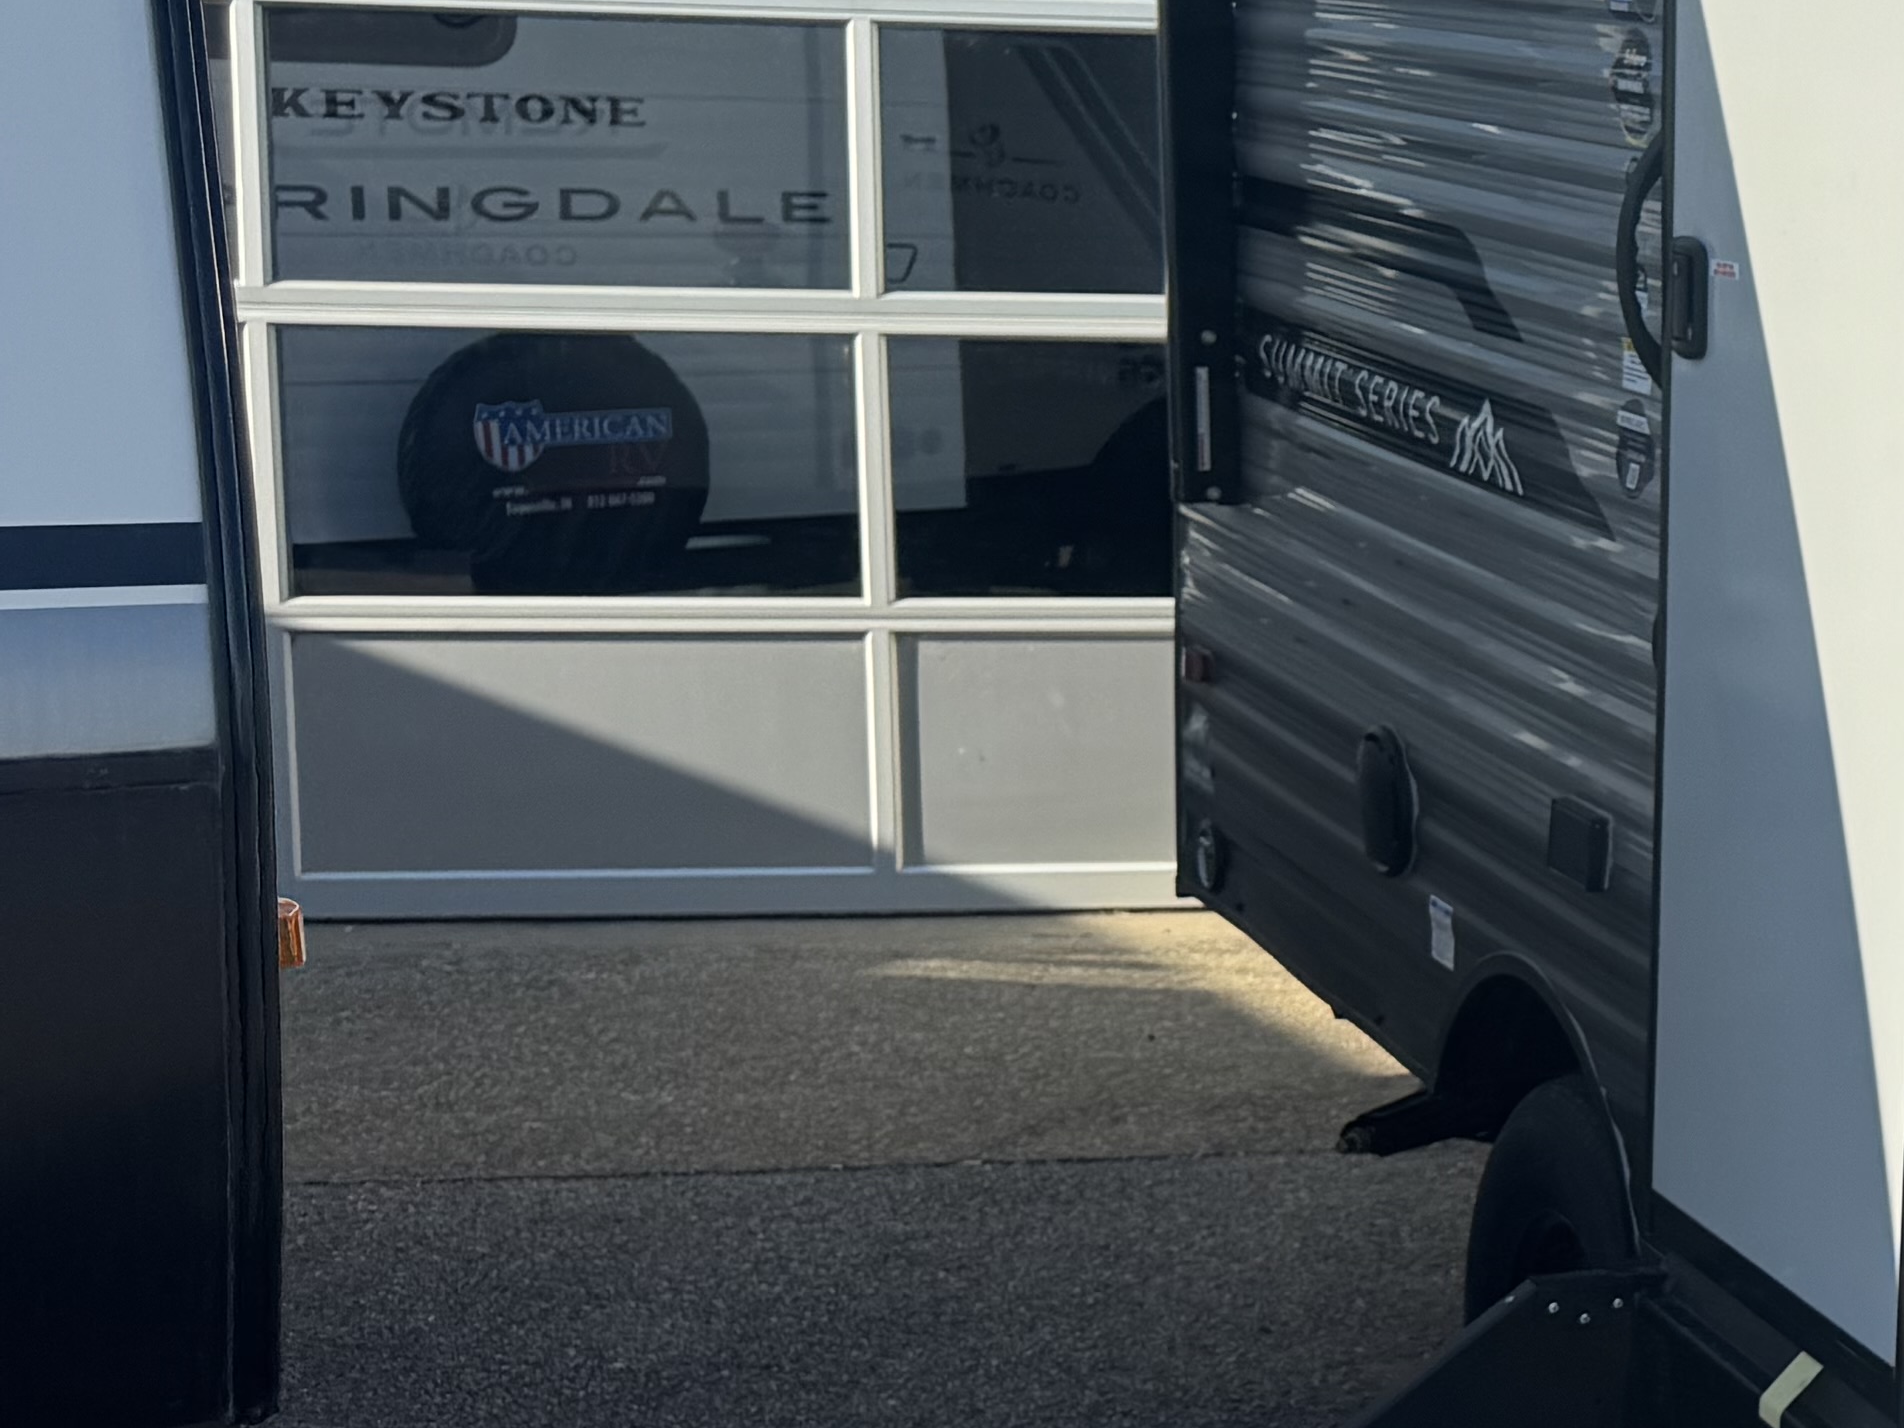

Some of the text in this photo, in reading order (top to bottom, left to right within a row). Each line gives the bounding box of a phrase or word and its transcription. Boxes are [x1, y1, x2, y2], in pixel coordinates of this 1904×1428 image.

[272, 87, 647, 127] KEYSTONE
[222, 183, 833, 225] RINGDALE
[1259, 334, 1440, 445] SUMMIT SERIES
[503, 415, 668, 446] AMERICAN
